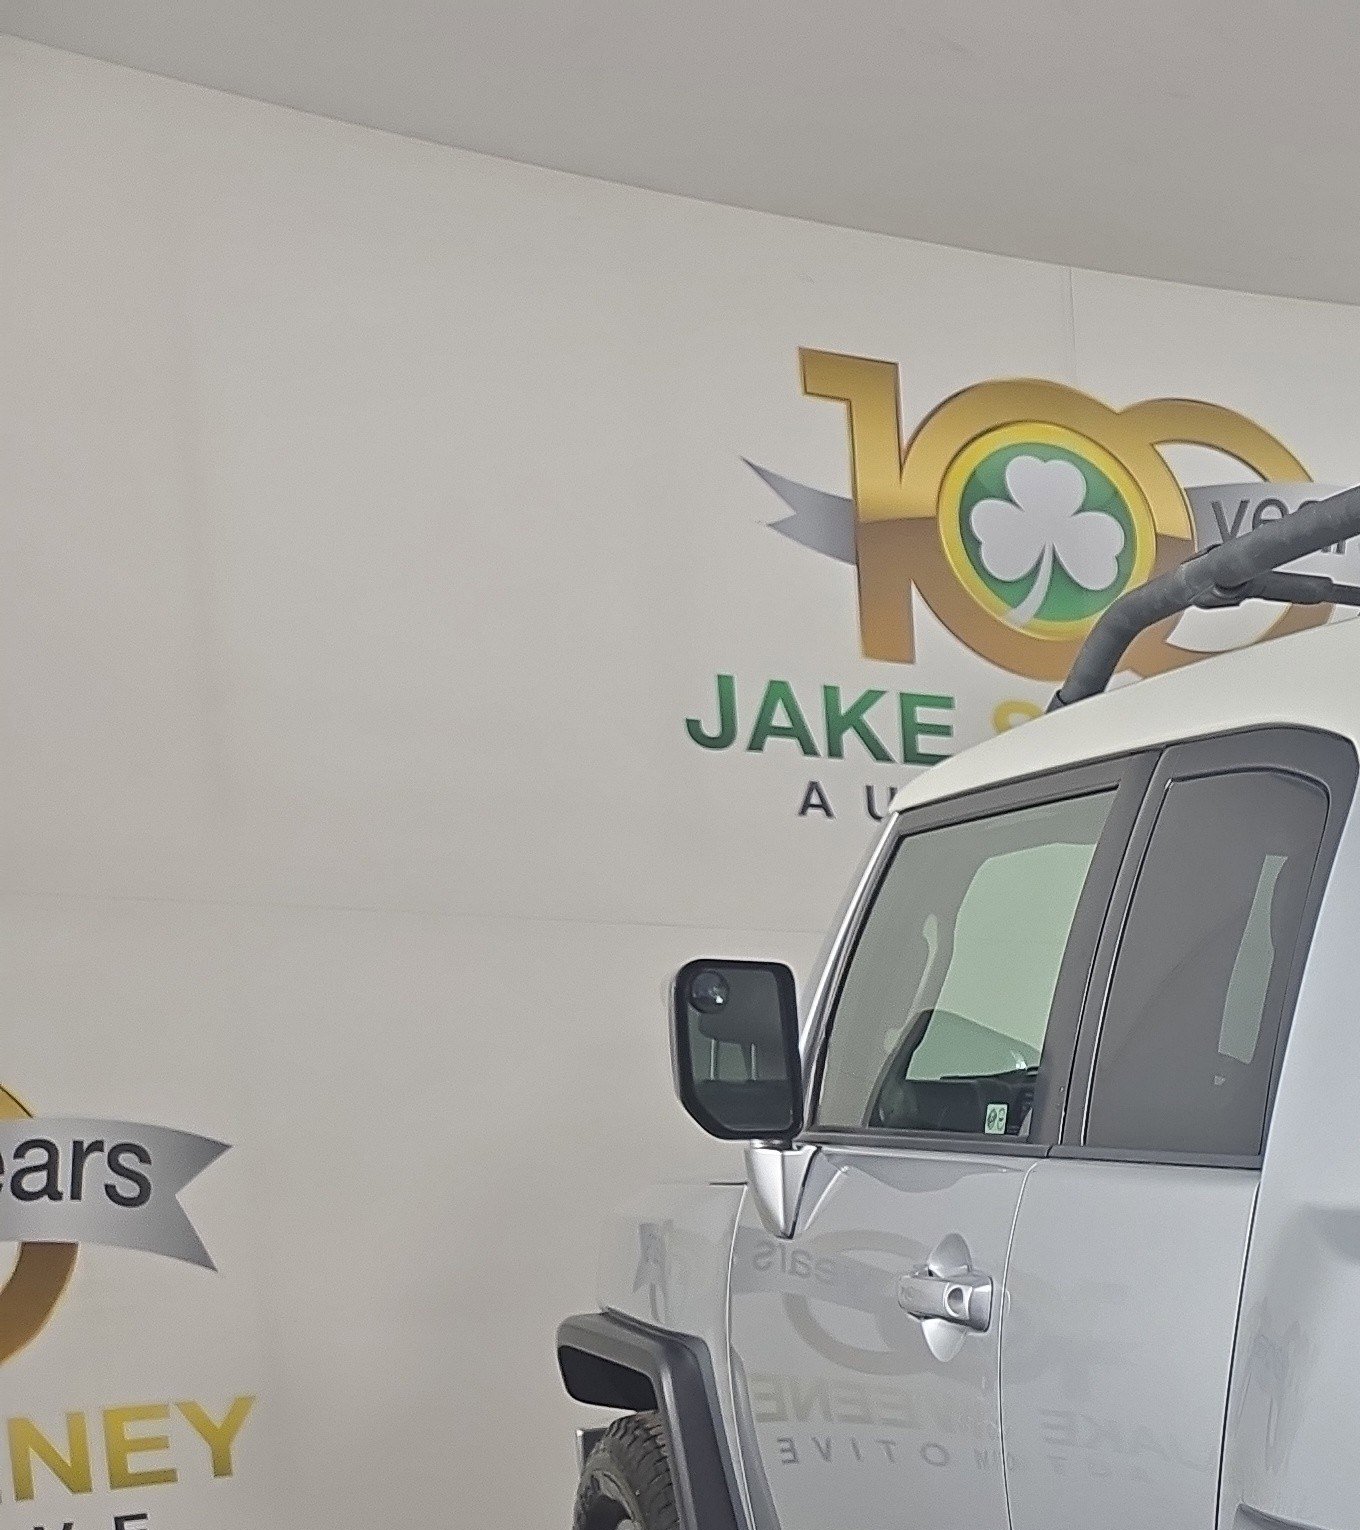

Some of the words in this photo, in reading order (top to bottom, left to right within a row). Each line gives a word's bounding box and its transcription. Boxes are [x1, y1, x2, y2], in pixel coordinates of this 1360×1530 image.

[684, 675, 956, 767] JAKE
[0, 1138, 152, 1208] ars
[0, 1396, 256, 1501] NEY
